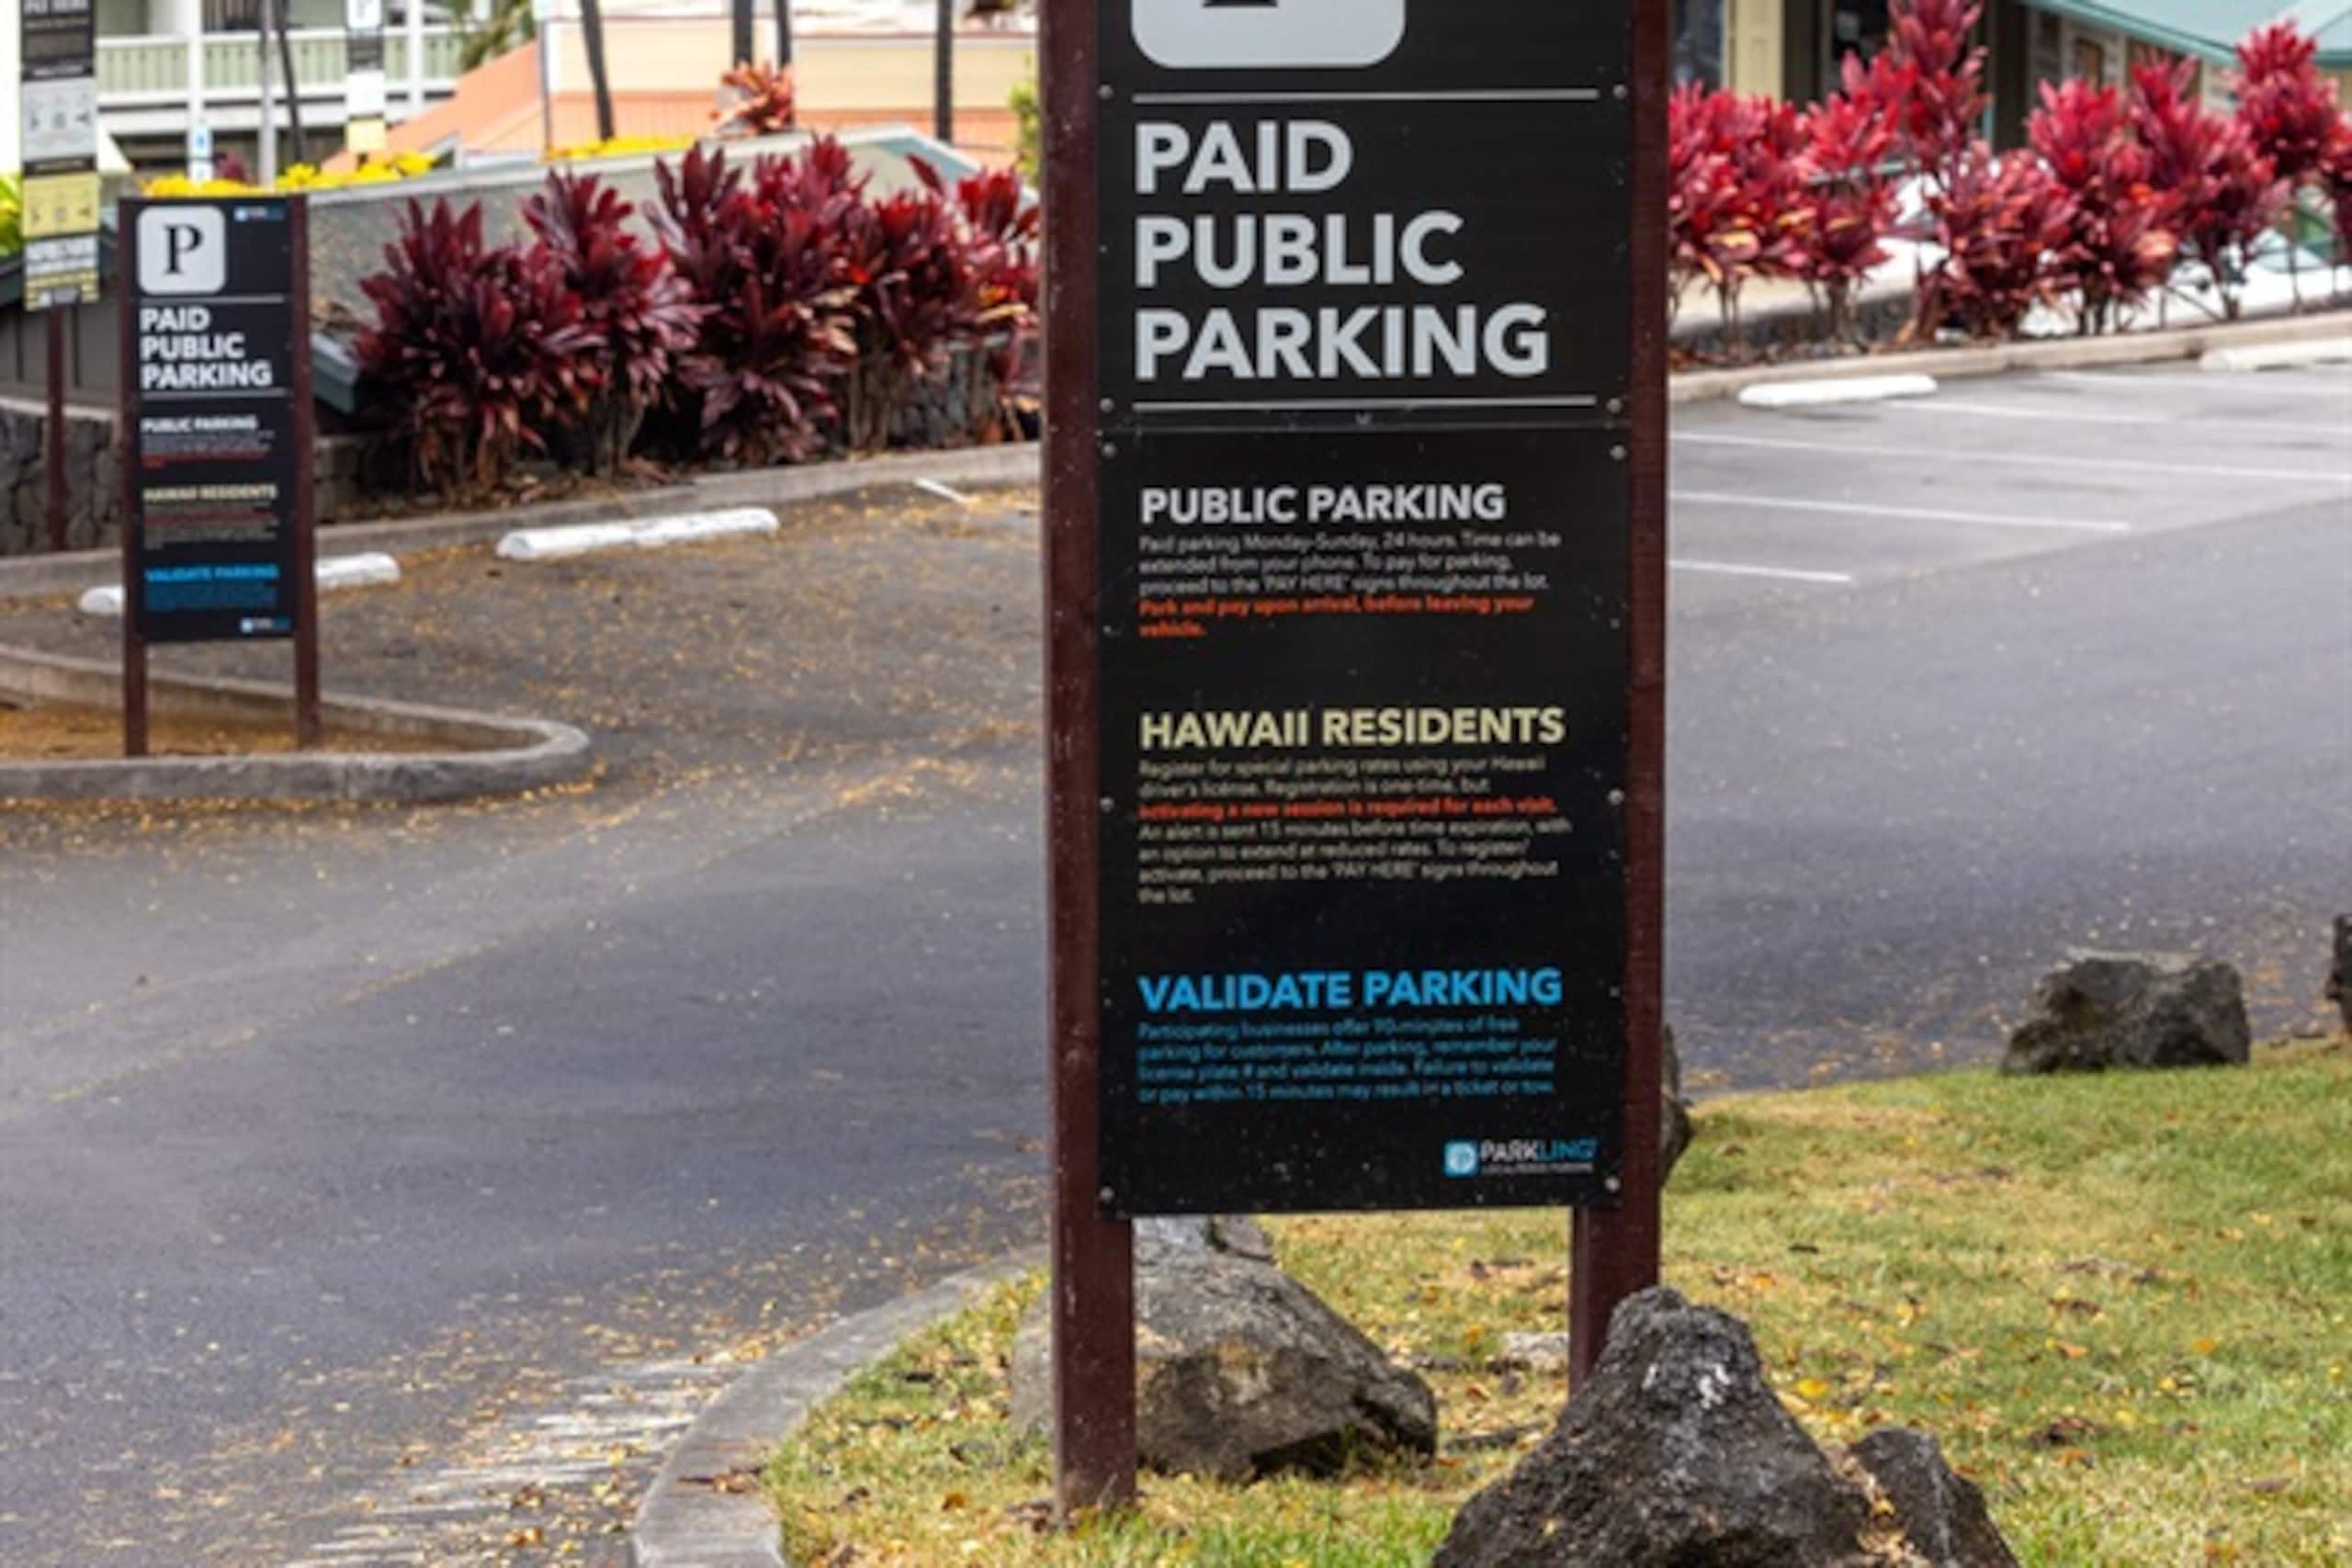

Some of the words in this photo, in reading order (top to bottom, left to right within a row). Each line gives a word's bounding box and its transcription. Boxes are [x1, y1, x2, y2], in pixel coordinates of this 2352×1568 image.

[1136, 120, 1353, 194] PAID
[164, 223, 203, 275] P
[1136, 210, 1464, 288] PUBLIC
[140, 306, 212, 333] PAID
[140, 332, 246, 360] PUBLIC
[1136, 303, 1550, 380] PARKING
[141, 359, 273, 389] PARKING
[140, 418, 191, 433] PUBLIC
[193, 415, 256, 430] PARKING
[1141, 487, 1298, 525] PUBLIC
[1306, 484, 1507, 521] PARKING
[1138, 535, 1175, 554] Paid
[1177, 536, 1240, 555] parking
[1382, 532, 1405, 549] 24
[1460, 530, 1503, 548] Time
[1504, 535, 1534, 548] can
[1536, 530, 1563, 547] be
[214, 563, 278, 579] PARKING
[1138, 556, 1217, 574] extended
[1218, 555, 1260, 573] from
[1261, 558, 1298, 574] your
[1362, 551, 1383, 570] To
[1384, 557, 1416, 572] pay
[1417, 552, 1443, 570] for
[1138, 577, 1209, 597] proceed
[1210, 578, 1229, 594] to
[1230, 577, 1260, 594] the
[1351, 577, 1396, 594] signs
[1397, 573, 1491, 593] throughout
[1491, 573, 1521, 591] the
[1138, 598, 1178, 616] Park
[1181, 597, 1217, 615] and
[1217, 601, 1250, 617] pay
[1252, 600, 1299, 616] upon
[1363, 594, 1422, 613] before
[1425, 594, 1491, 615] leaving
[1492, 597, 1535, 615] your
[1141, 711, 1309, 750] HAWAII
[1321, 705, 1566, 746] RESIDENTS
[1206, 758, 1232, 776] for
[1294, 759, 1358, 778] parking
[1359, 759, 1401, 774] rates
[1401, 758, 1449, 775] using
[1450, 760, 1488, 776] your
[1363, 778, 1378, 794] is
[1459, 777, 1492, 794] but
[1138, 802, 1226, 823] activating
[1227, 805, 1240, 818] a
[1241, 804, 1281, 818] new
[1282, 800, 1347, 818] session
[1347, 799, 1363, 817] is
[1365, 796, 1442, 818] required
[1442, 795, 1469, 816] for
[1471, 795, 1515, 814] each
[1138, 824, 1163, 840] An
[1205, 823, 1221, 839] is
[1221, 823, 1258, 839] sent
[1260, 821, 1283, 838] 15
[1283, 820, 1351, 838] minutes
[1351, 819, 1407, 837] before
[1407, 820, 1446, 836] time
[1534, 818, 1574, 834] with
[1138, 847, 1162, 863] an
[1161, 845, 1217, 863] option
[1217, 845, 1237, 861] to
[1238, 842, 1298, 860] extend
[1299, 843, 1317, 859] at
[1436, 838, 1456, 856] To
[1206, 864, 1279, 884] proceed
[1279, 864, 1299, 880] to
[1299, 863, 1329, 879] the
[1419, 863, 1464, 882] signs
[1464, 859, 1559, 880] throughout
[1138, 887, 1167, 904] the
[1137, 971, 1351, 1010] VALIDATE
[1363, 966, 1563, 1007] PARKING
